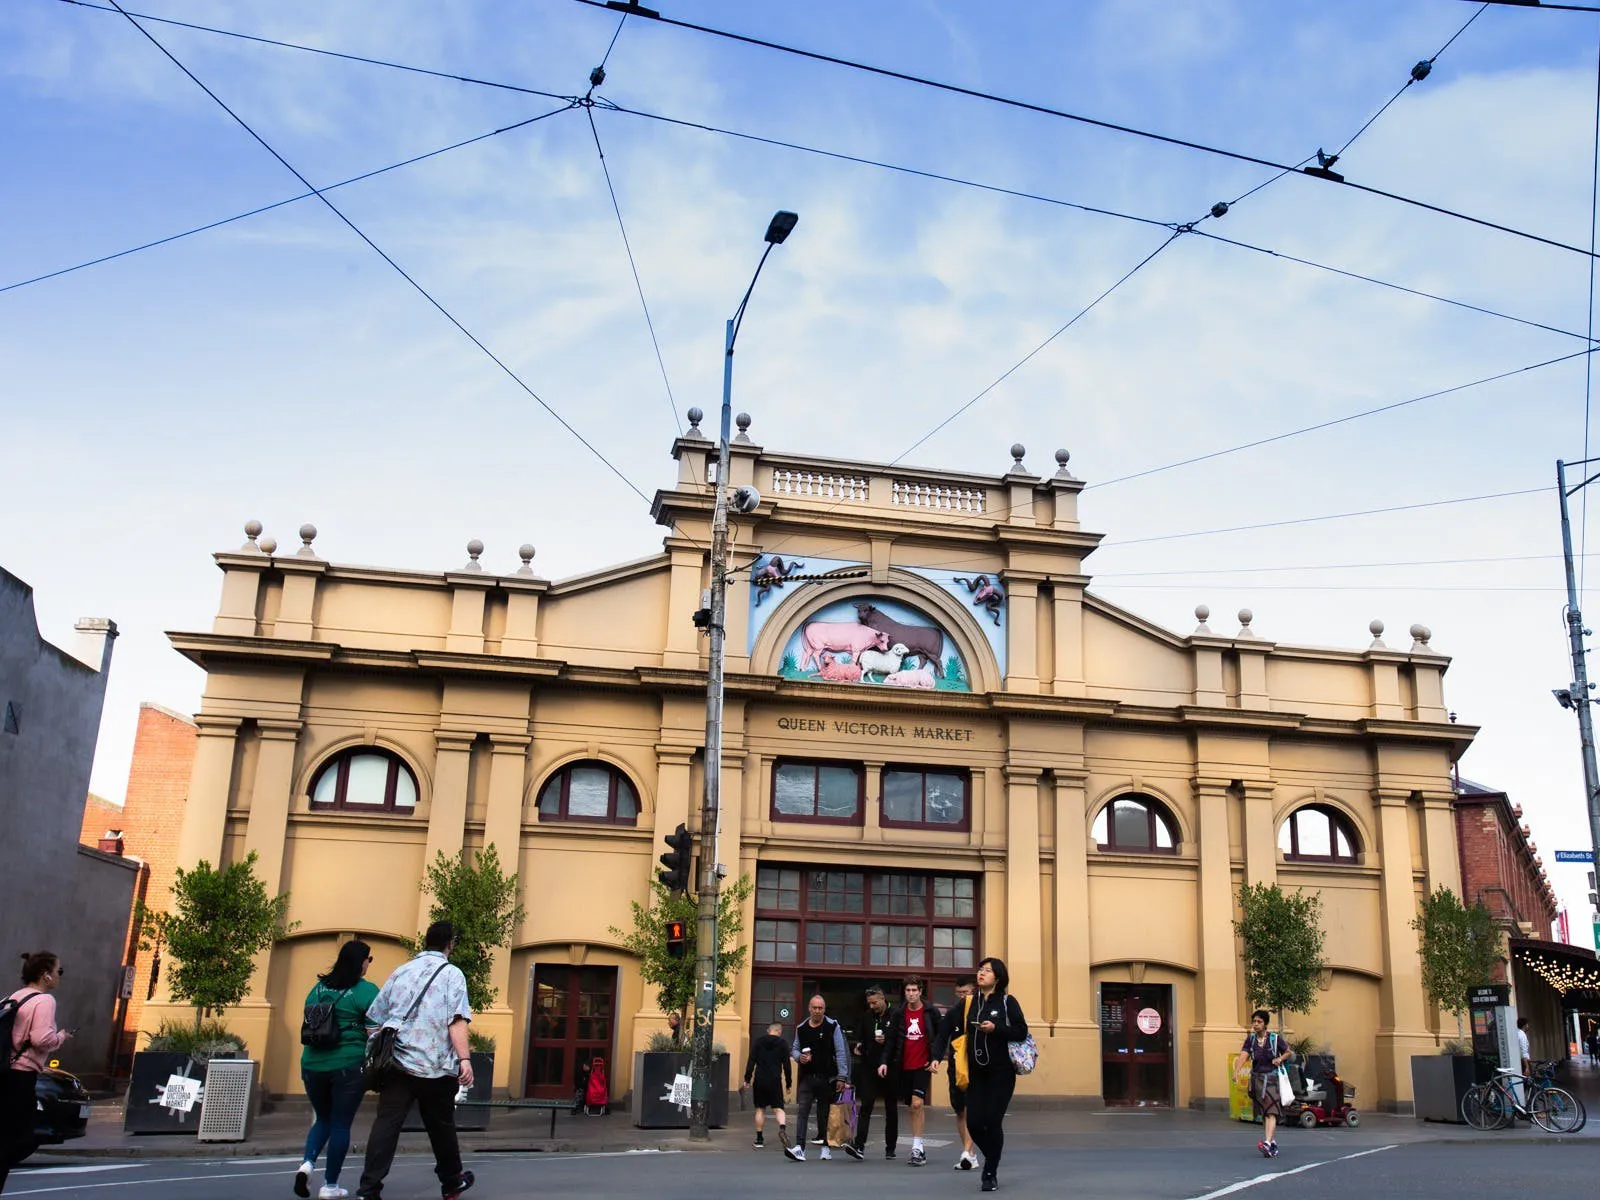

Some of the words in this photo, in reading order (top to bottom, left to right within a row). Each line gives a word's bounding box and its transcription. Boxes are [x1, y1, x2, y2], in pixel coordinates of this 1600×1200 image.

[777, 717, 826, 732] QUEEN
[834, 721, 905, 737] VICTORIA
[914, 726, 972, 741] MARKET
[167, 1084, 185, 1092] QUEEN
[166, 1092, 191, 1100] VICTORIA
[166, 1099, 187, 1107] MARKET
